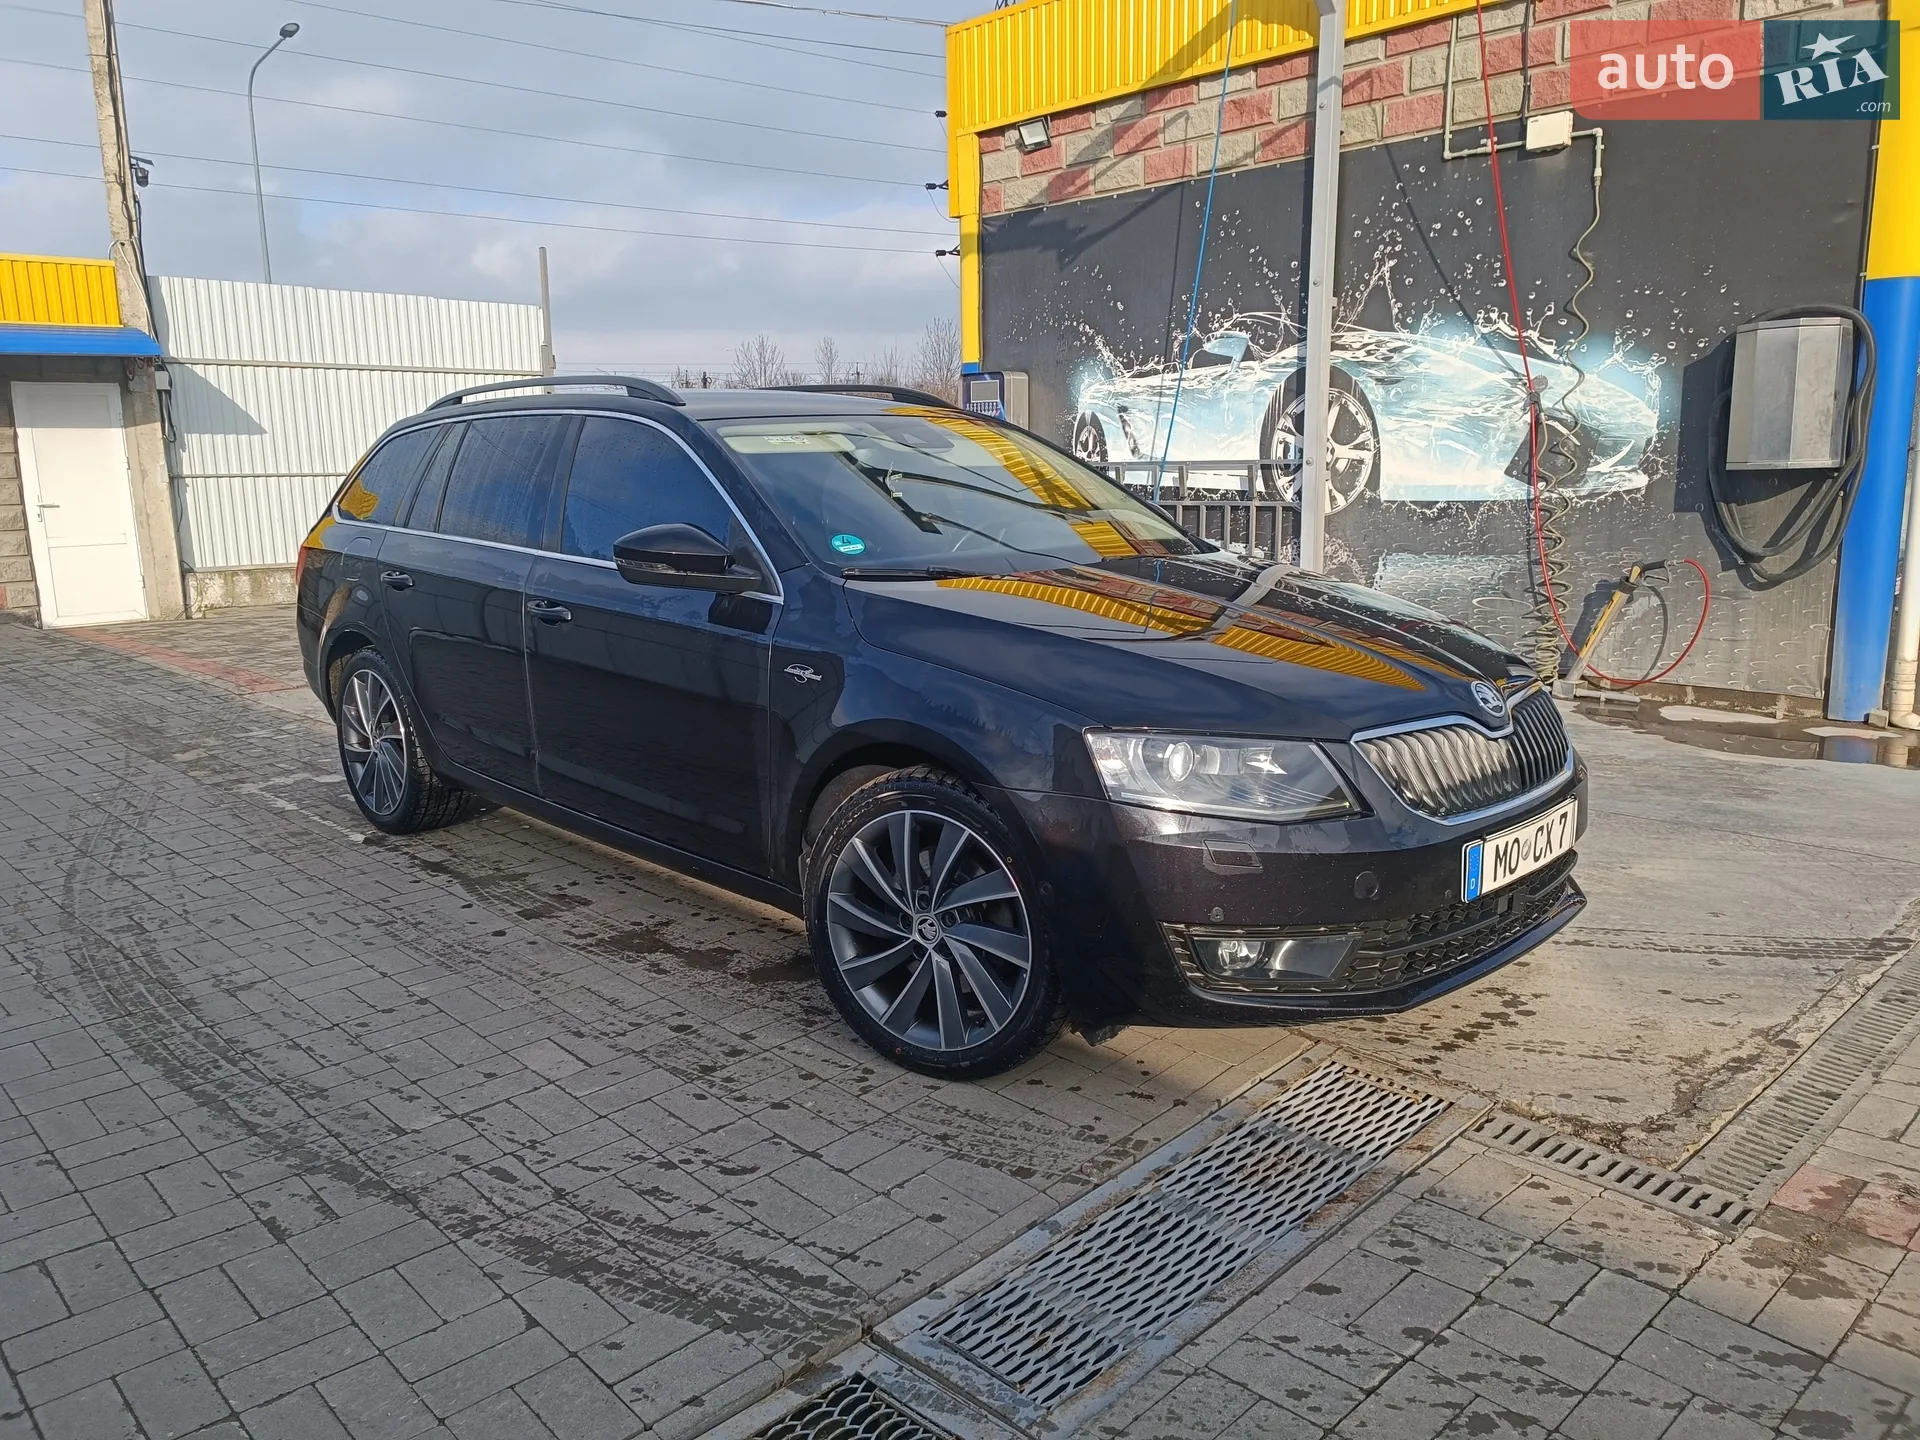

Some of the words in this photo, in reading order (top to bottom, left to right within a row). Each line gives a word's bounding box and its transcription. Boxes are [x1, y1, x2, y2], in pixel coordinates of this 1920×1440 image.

[1493, 837, 1520, 882] MO
[1533, 819, 1554, 863] CX
[1559, 811, 1568, 849] 7
[1470, 878, 1476, 890] D
